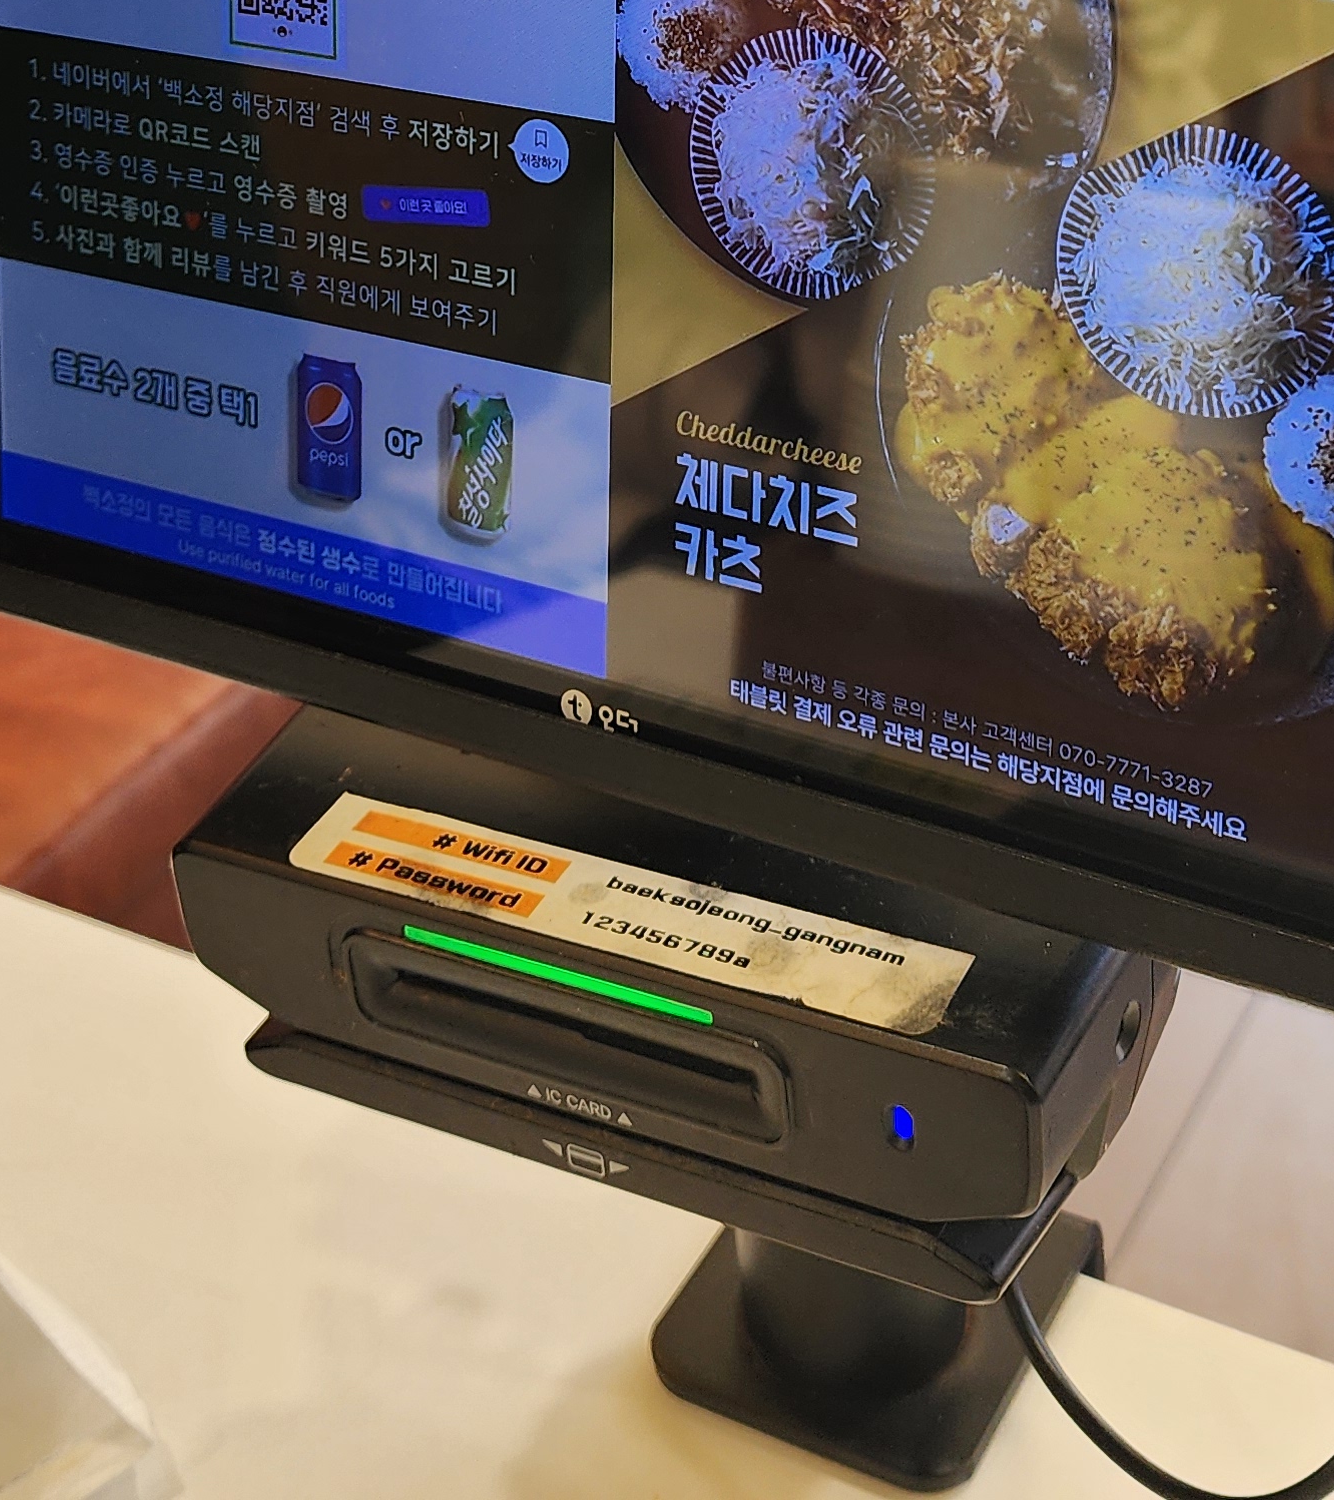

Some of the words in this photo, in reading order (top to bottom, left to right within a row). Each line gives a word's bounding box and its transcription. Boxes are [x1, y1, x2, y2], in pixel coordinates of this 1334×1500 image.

[52, 61, 150, 100] 네이버에서
[329, 105, 371, 138] 검색
[379, 112, 400, 141] 후
[408, 118, 501, 160] 저장하기
[53, 102, 133, 136] 카메라로
[139, 117, 213, 150] QR코드
[219, 131, 261, 162] 스캔
[54, 142, 113, 177] 영수증
[120, 154, 159, 186] 인증
[166, 163, 227, 195] 누르고
[233, 174, 298, 212] 영수증
[305, 186, 349, 220] 촬영
[520, 150, 564, 173] 저장하기
[55, 223, 117, 259] 사진과
[123, 236, 163, 269] 함께
[171, 247, 233, 283] 리뷰를
[239, 259, 280, 292] 남긴
[288, 268, 308, 298] 후
[316, 274, 402, 317] 직원에게
[409, 295, 498, 337] 보여주기
[236, 218, 298, 250] 누르고
[305, 230, 371, 265] 키워드
[379, 246, 439, 281] 5가지
[448, 258, 516, 297] 고르기
[53, 347, 129, 397] 음료수
[134, 367, 178, 410] 2개
[185, 376, 212, 418] 중
[309, 448, 350, 468] pepsi
[385, 427, 423, 460] or
[676, 410, 863, 475] Cheddarcheese
[675, 452, 859, 547] 체다치즈
[178, 537, 206, 560] Use
[207, 545, 263, 575] purified
[266, 561, 306, 586] water
[310, 571, 330, 592] for
[333, 578, 351, 598] all
[354, 583, 396, 610] foods
[258, 528, 315, 565] 정수된
[321, 543, 381, 583] 생수로
[387, 562, 503, 615] 만들어집니다
[674, 521, 763, 594] 카츠
[729, 678, 788, 716] 태블릿
[792, 693, 832, 729] 결제
[836, 709, 878, 740] 오류
[882, 719, 923, 753] 관련
[928, 732, 993, 774] 문의는
[997, 750, 1105, 806] 해당지점에
[1111, 783, 1249, 843] 문의해주세요
[761, 660, 826, 694] 불편사항
[831, 678, 848, 700] 등
[854, 685, 887, 711] 각종
[892, 696, 927, 722] 문의
[942, 708, 977, 735] 본사
[982, 721, 1053, 758] 고객센터
[1058, 742, 1214, 799] 070-7771-3287
[375, 856, 523, 910] Password
[581, 910, 752, 969] 123456789a
[462, 839, 515, 867] Wifi
[517, 854, 549, 875] ID
[605, 875, 906, 967] baeksojeong_gangnam
[545, 1086, 562, 1106] IC
[566, 1094, 612, 1121] CARD
